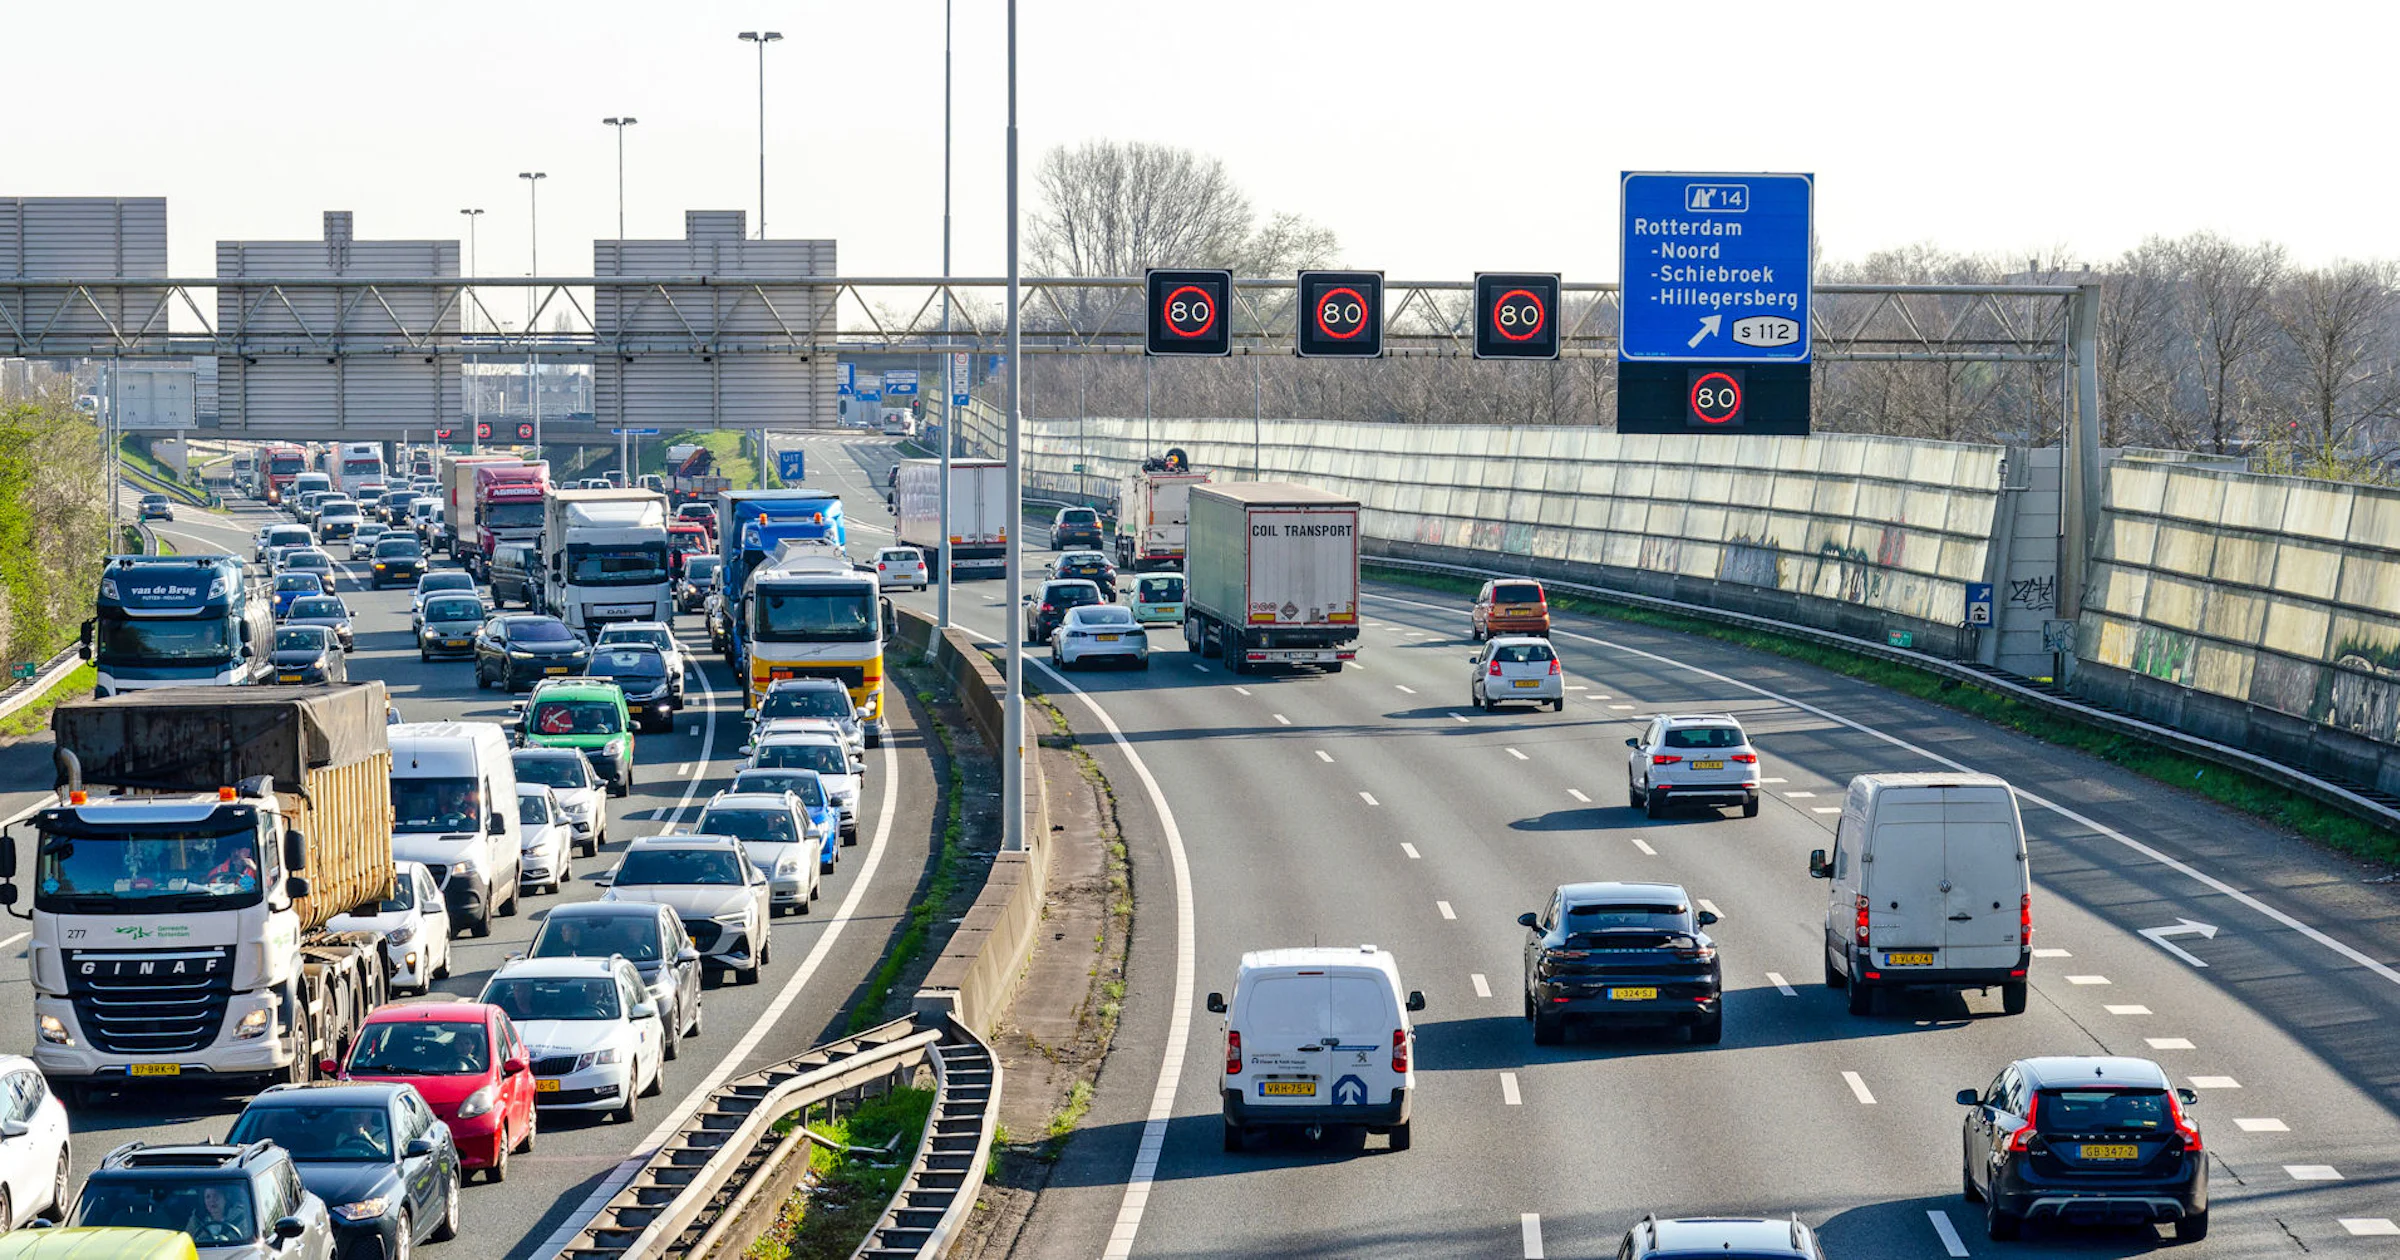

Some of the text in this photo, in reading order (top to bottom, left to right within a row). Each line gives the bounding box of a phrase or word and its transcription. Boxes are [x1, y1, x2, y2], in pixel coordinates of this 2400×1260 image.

[1721, 191, 1742, 206] 14
[1634, 218, 1742, 236] Rotterdam
[1651, 242, 1720, 259] -Noord
[1651, 265, 1774, 283] -Schiebroek
[1651, 288, 1798, 310] -Hillegersberg
[1170, 301, 1209, 323] 80
[1323, 302, 1362, 324] 80
[1500, 304, 1539, 326] 80
[1759, 323, 1790, 340] 112
[1697, 388, 1736, 408] 80
[782, 454, 800, 462] UIT
[493, 487, 541, 497] AGROMEX
[1252, 525, 1353, 537] COIL TRANSPORT
[131, 585, 197, 597] van de Brug
[67, 929, 87, 939] 277
[81, 959, 217, 974] GINAF
[1615, 989, 1653, 998] L-324-SJ
[133, 1064, 177, 1075] 37-BRK-9
[1267, 1083, 1312, 1094] VRH-75-V
[2085, 1146, 2134, 1157] GB-347-Z
